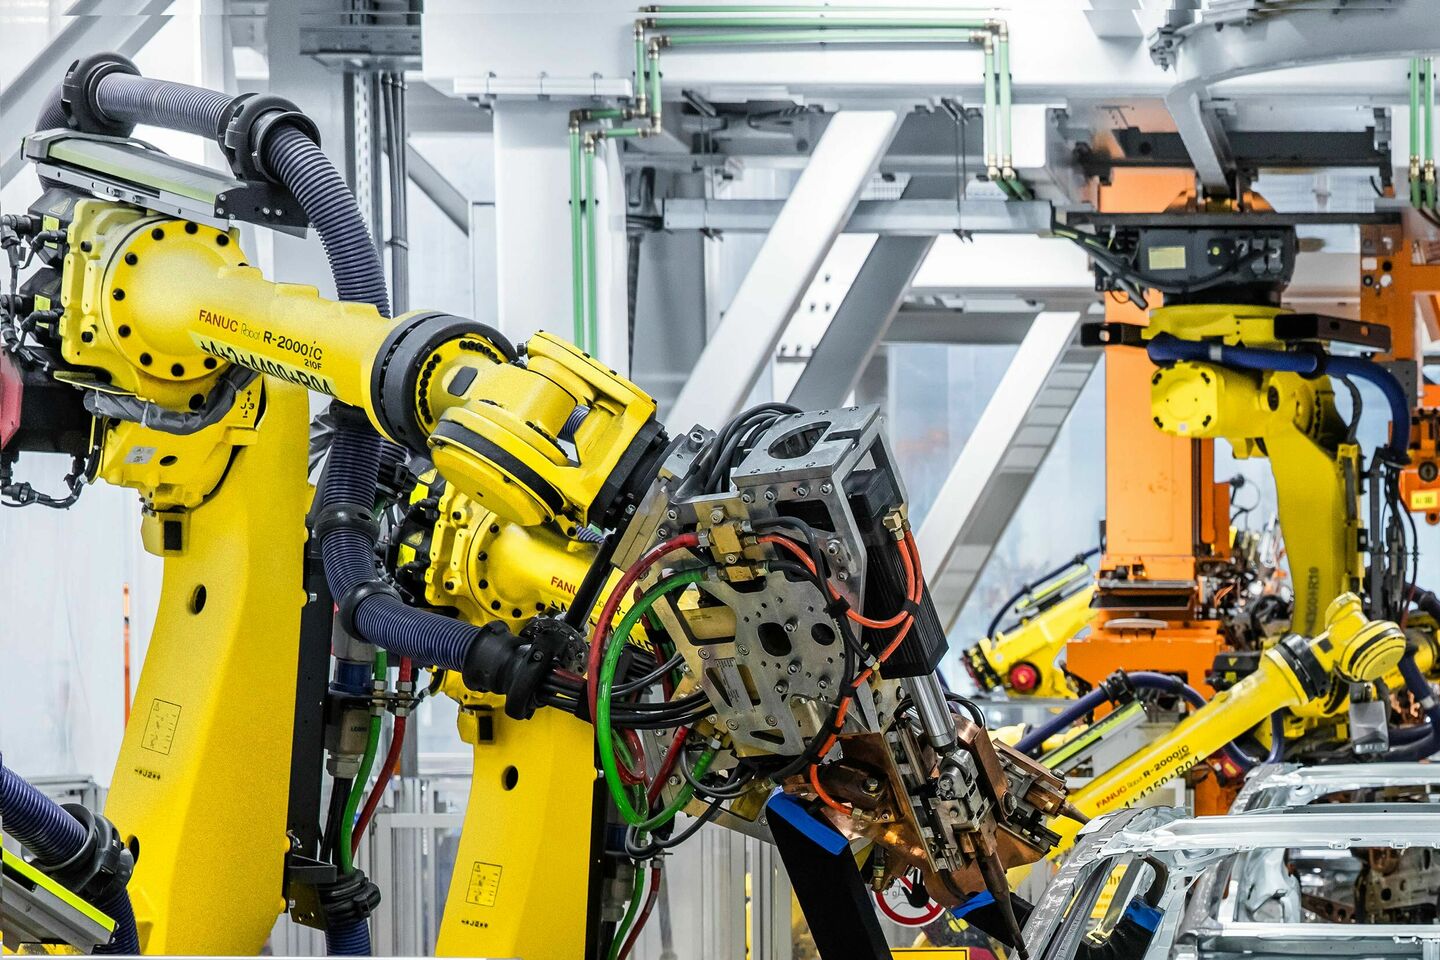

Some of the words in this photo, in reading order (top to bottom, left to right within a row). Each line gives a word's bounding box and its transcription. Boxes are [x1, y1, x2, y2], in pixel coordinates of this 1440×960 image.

[199, 309, 239, 332] FANUC
[240, 323, 261, 339] Robot
[263, 331, 323, 361] R-2000iC
[304, 358, 322, 370] 210F
[1096, 785, 1127, 808] FANUC
